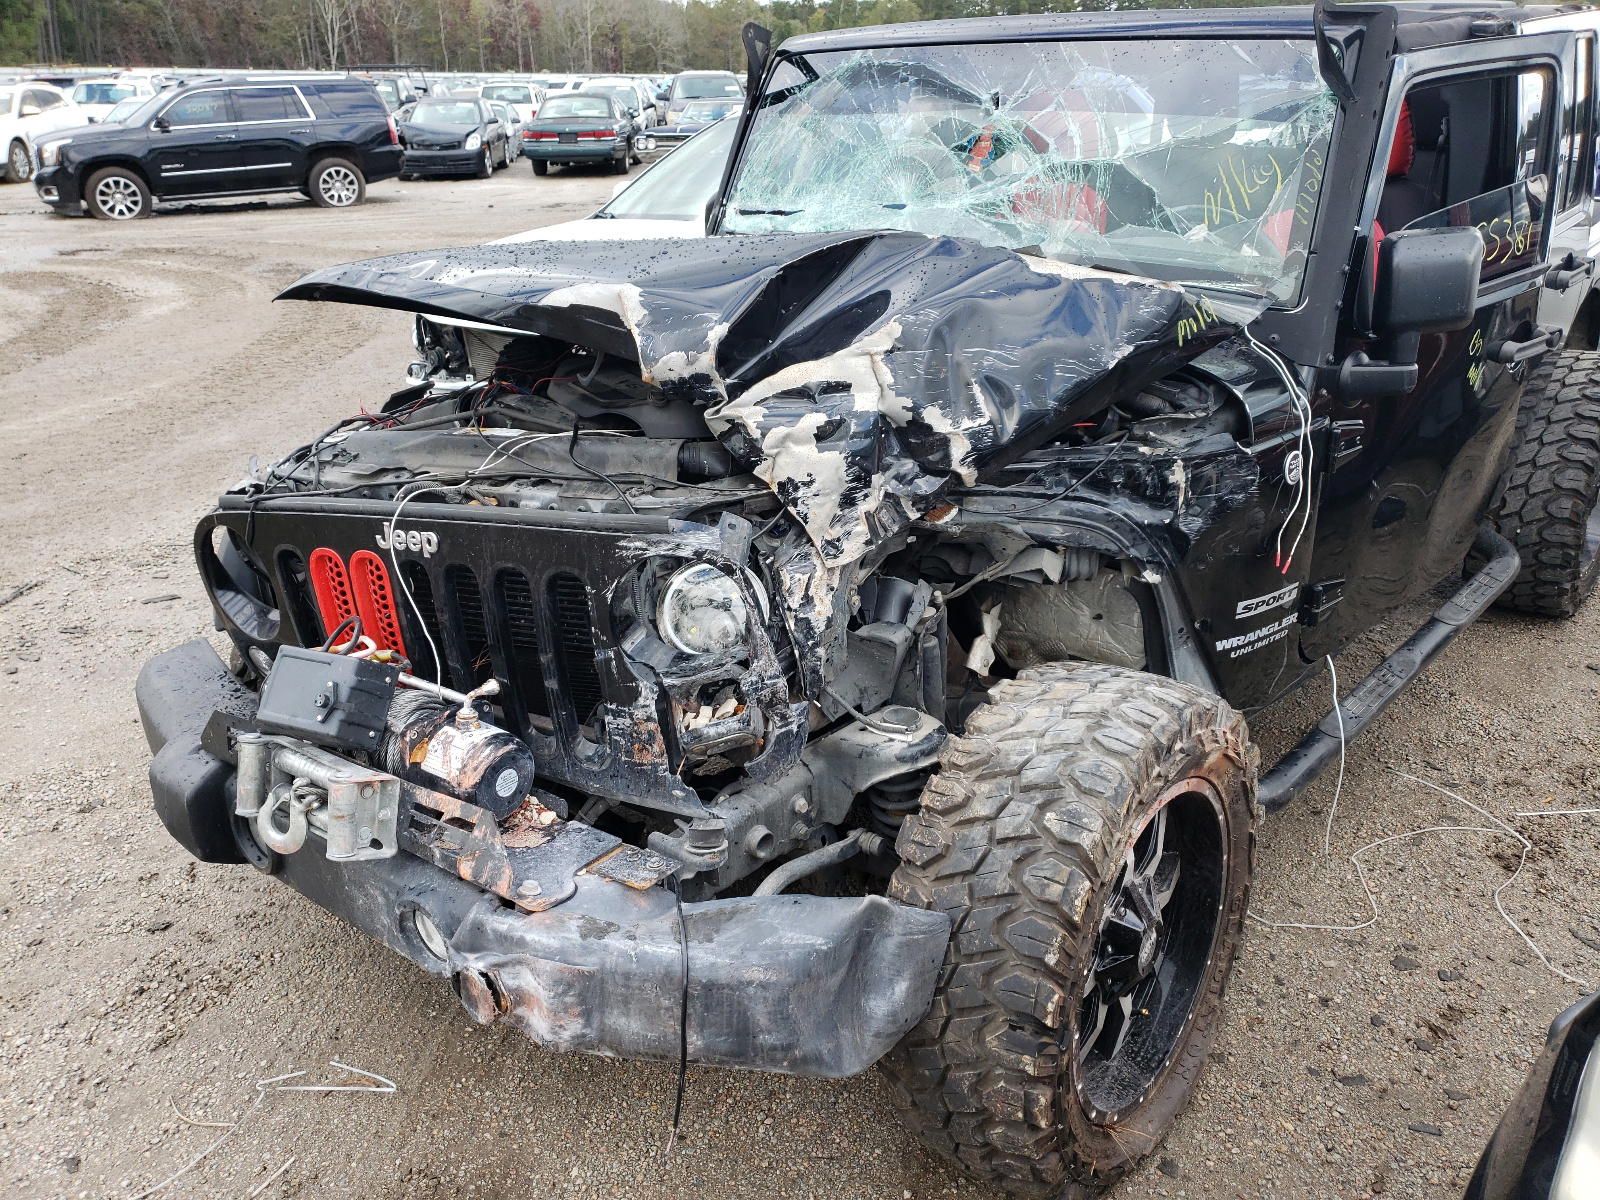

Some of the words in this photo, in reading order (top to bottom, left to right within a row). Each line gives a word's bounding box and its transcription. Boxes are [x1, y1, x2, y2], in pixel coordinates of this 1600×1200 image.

[375, 521, 439, 559] Jeep
[1236, 584, 1298, 616] SPORT
[1215, 612, 1299, 651] WRANGLER
[1230, 629, 1289, 658] UNLIMITED
